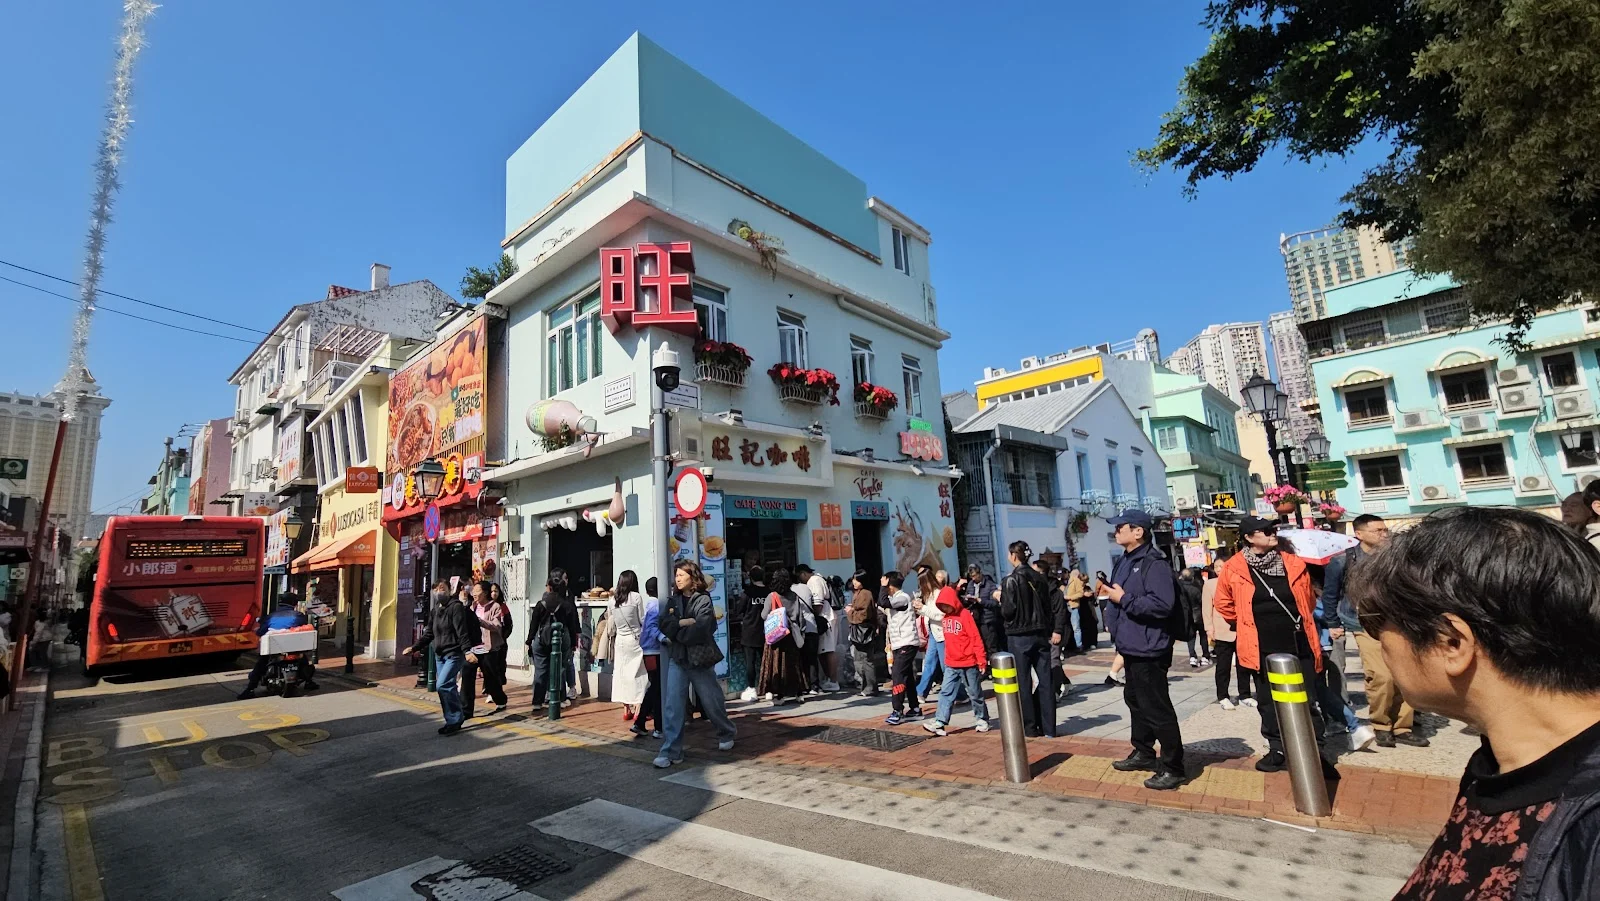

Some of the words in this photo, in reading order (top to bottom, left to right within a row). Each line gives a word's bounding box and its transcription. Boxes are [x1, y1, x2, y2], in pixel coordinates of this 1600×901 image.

[600, 241, 697, 324] 旺
[711, 435, 811, 472] 旺記咖啡
[735, 498, 756, 510] CAFÉ
[759, 500, 783, 510] VONG
[784, 501, 798, 511] KEI
[937, 482, 951, 518] 旺記
[123, 561, 178, 577] 小郎酒
[46, 710, 302, 768] BUS
[40, 727, 331, 805] STOP
